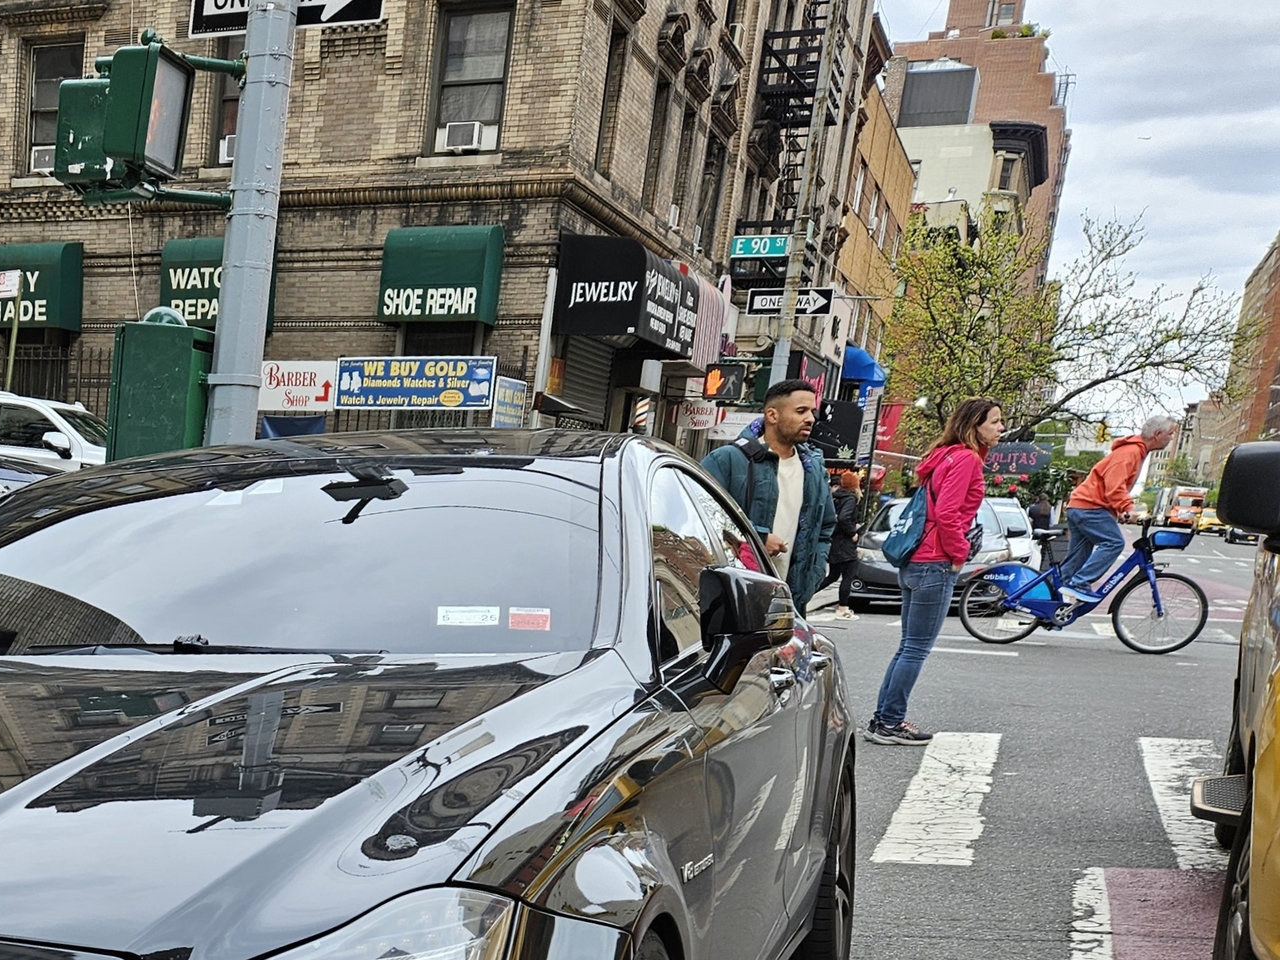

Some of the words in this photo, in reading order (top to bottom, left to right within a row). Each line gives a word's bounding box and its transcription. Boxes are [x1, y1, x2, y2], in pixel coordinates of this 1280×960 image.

[735, 238, 746, 254] E
[751, 238, 771, 254] 90
[775, 238, 785, 247] ST
[383, 287, 423, 316] SHOE
[425, 286, 477, 315] REPAIR
[567, 280, 638, 309] JEWELRY
[760, 297, 783, 307] ONE
[363, 360, 386, 376] WE
[389, 360, 421, 377] BUY
[424, 360, 468, 377] GOLD
[362, 377, 401, 388] Diamonds
[403, 377, 436, 388] Watches
[438, 378, 445, 388] &
[446, 377, 470, 388] Silver
[340, 395, 365, 405] Watch
[367, 395, 374, 405] &
[376, 395, 409, 407] Jewelry
[411, 395, 438, 406] Repair
